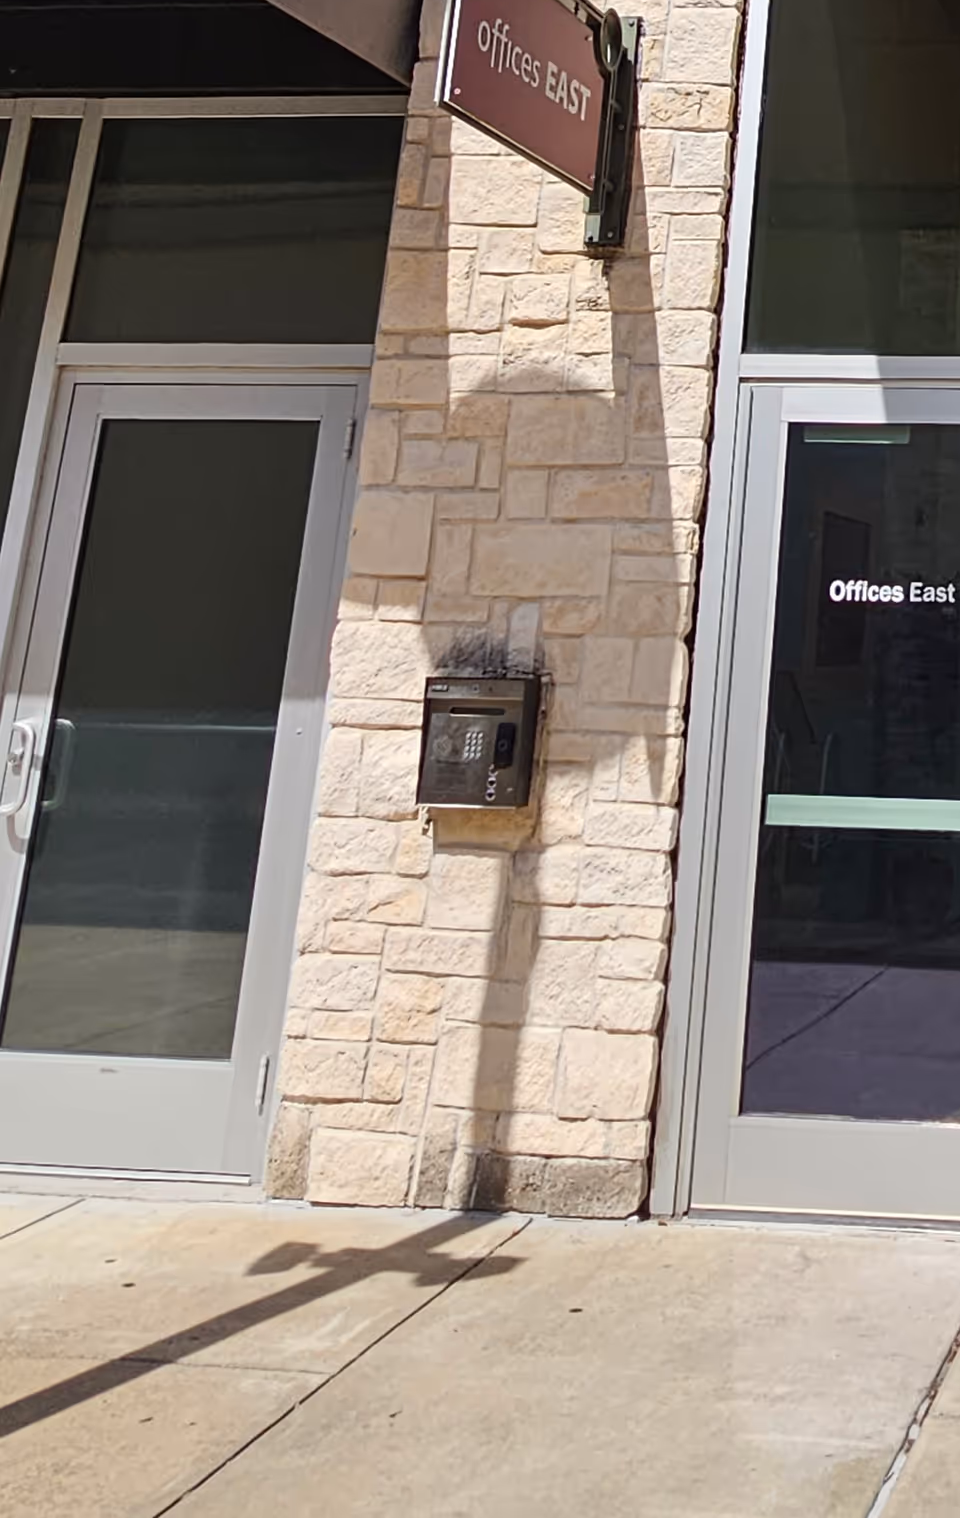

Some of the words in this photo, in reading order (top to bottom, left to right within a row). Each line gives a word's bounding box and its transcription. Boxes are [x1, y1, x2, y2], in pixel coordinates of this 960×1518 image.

[477, 18, 540, 88] offices
[544, 61, 590, 121] EAST
[829, 580, 904, 603] Offices
[910, 582, 956, 603] East
